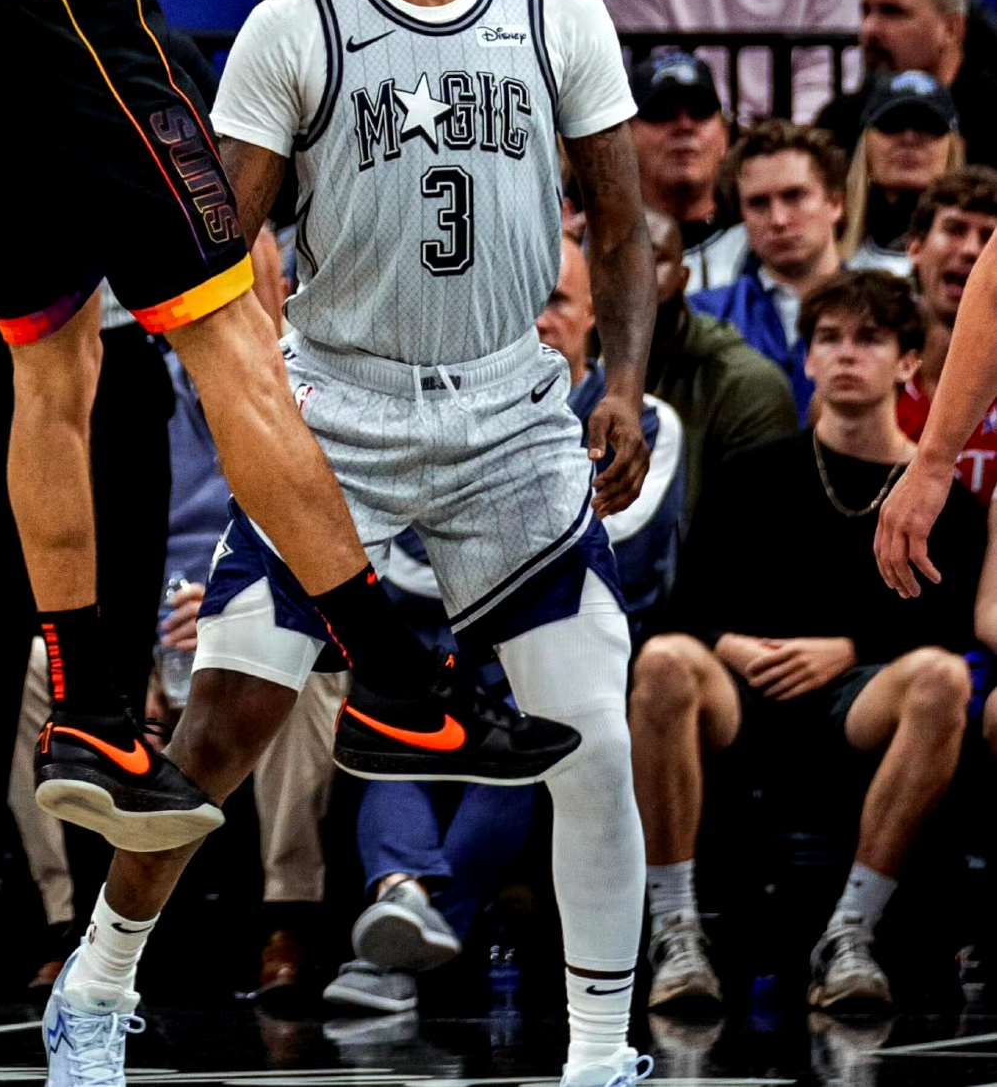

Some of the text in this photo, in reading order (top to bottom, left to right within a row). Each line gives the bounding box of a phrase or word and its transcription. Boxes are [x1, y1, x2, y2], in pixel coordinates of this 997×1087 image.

[476, 26, 527, 45] Disney
[149, 105, 241, 244] SUNS
[420, 165, 474, 277] 3
